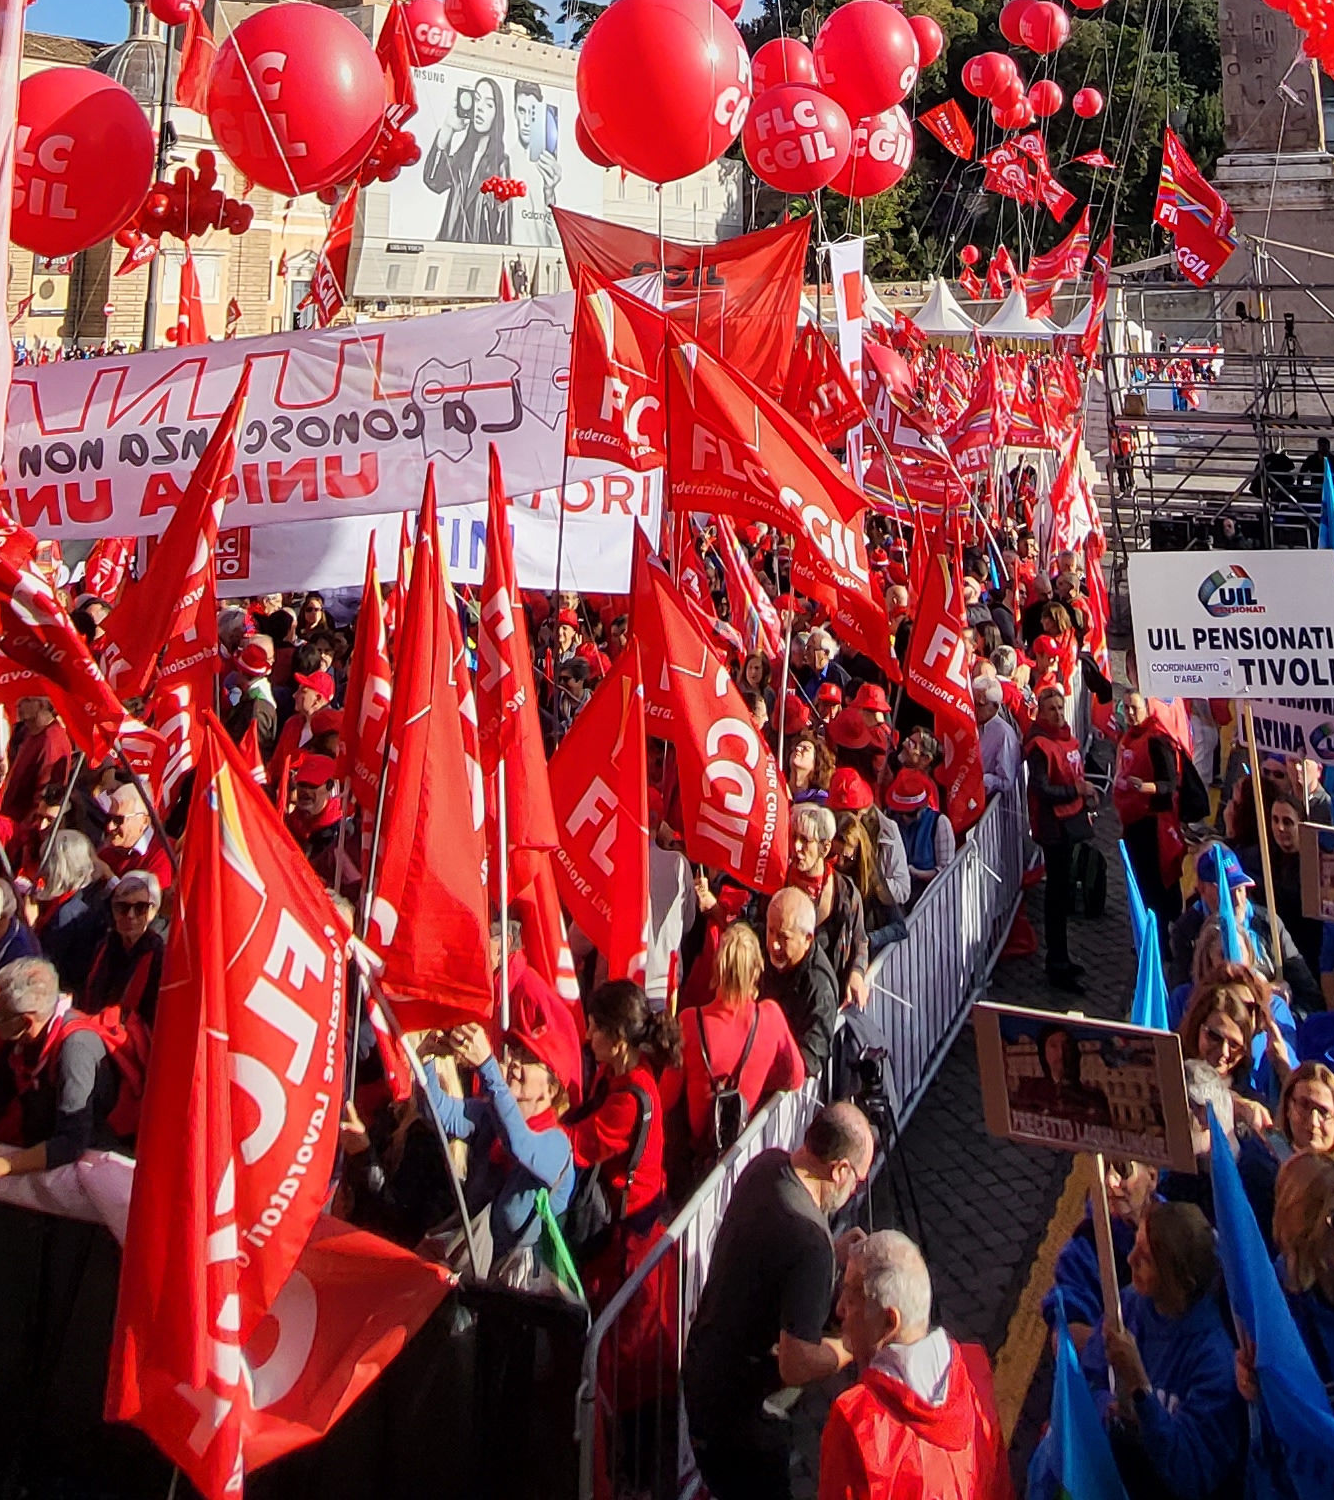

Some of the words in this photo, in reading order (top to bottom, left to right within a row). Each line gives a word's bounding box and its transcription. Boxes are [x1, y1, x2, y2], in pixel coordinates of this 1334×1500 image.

[416, 23, 453, 49] CGIL
[755, 99, 819, 143] FLC
[756, 131, 836, 174] CGIL
[1219, 587, 1258, 606] UIL
[1214, 605, 1266, 614] PENSIONATI
[1147, 627, 1187, 652] UIL
[1192, 626, 1334, 651] PENSIONATI
[1150, 662, 1219, 674] COORDINAMENTO
[1173, 674, 1204, 685] D'AREA
